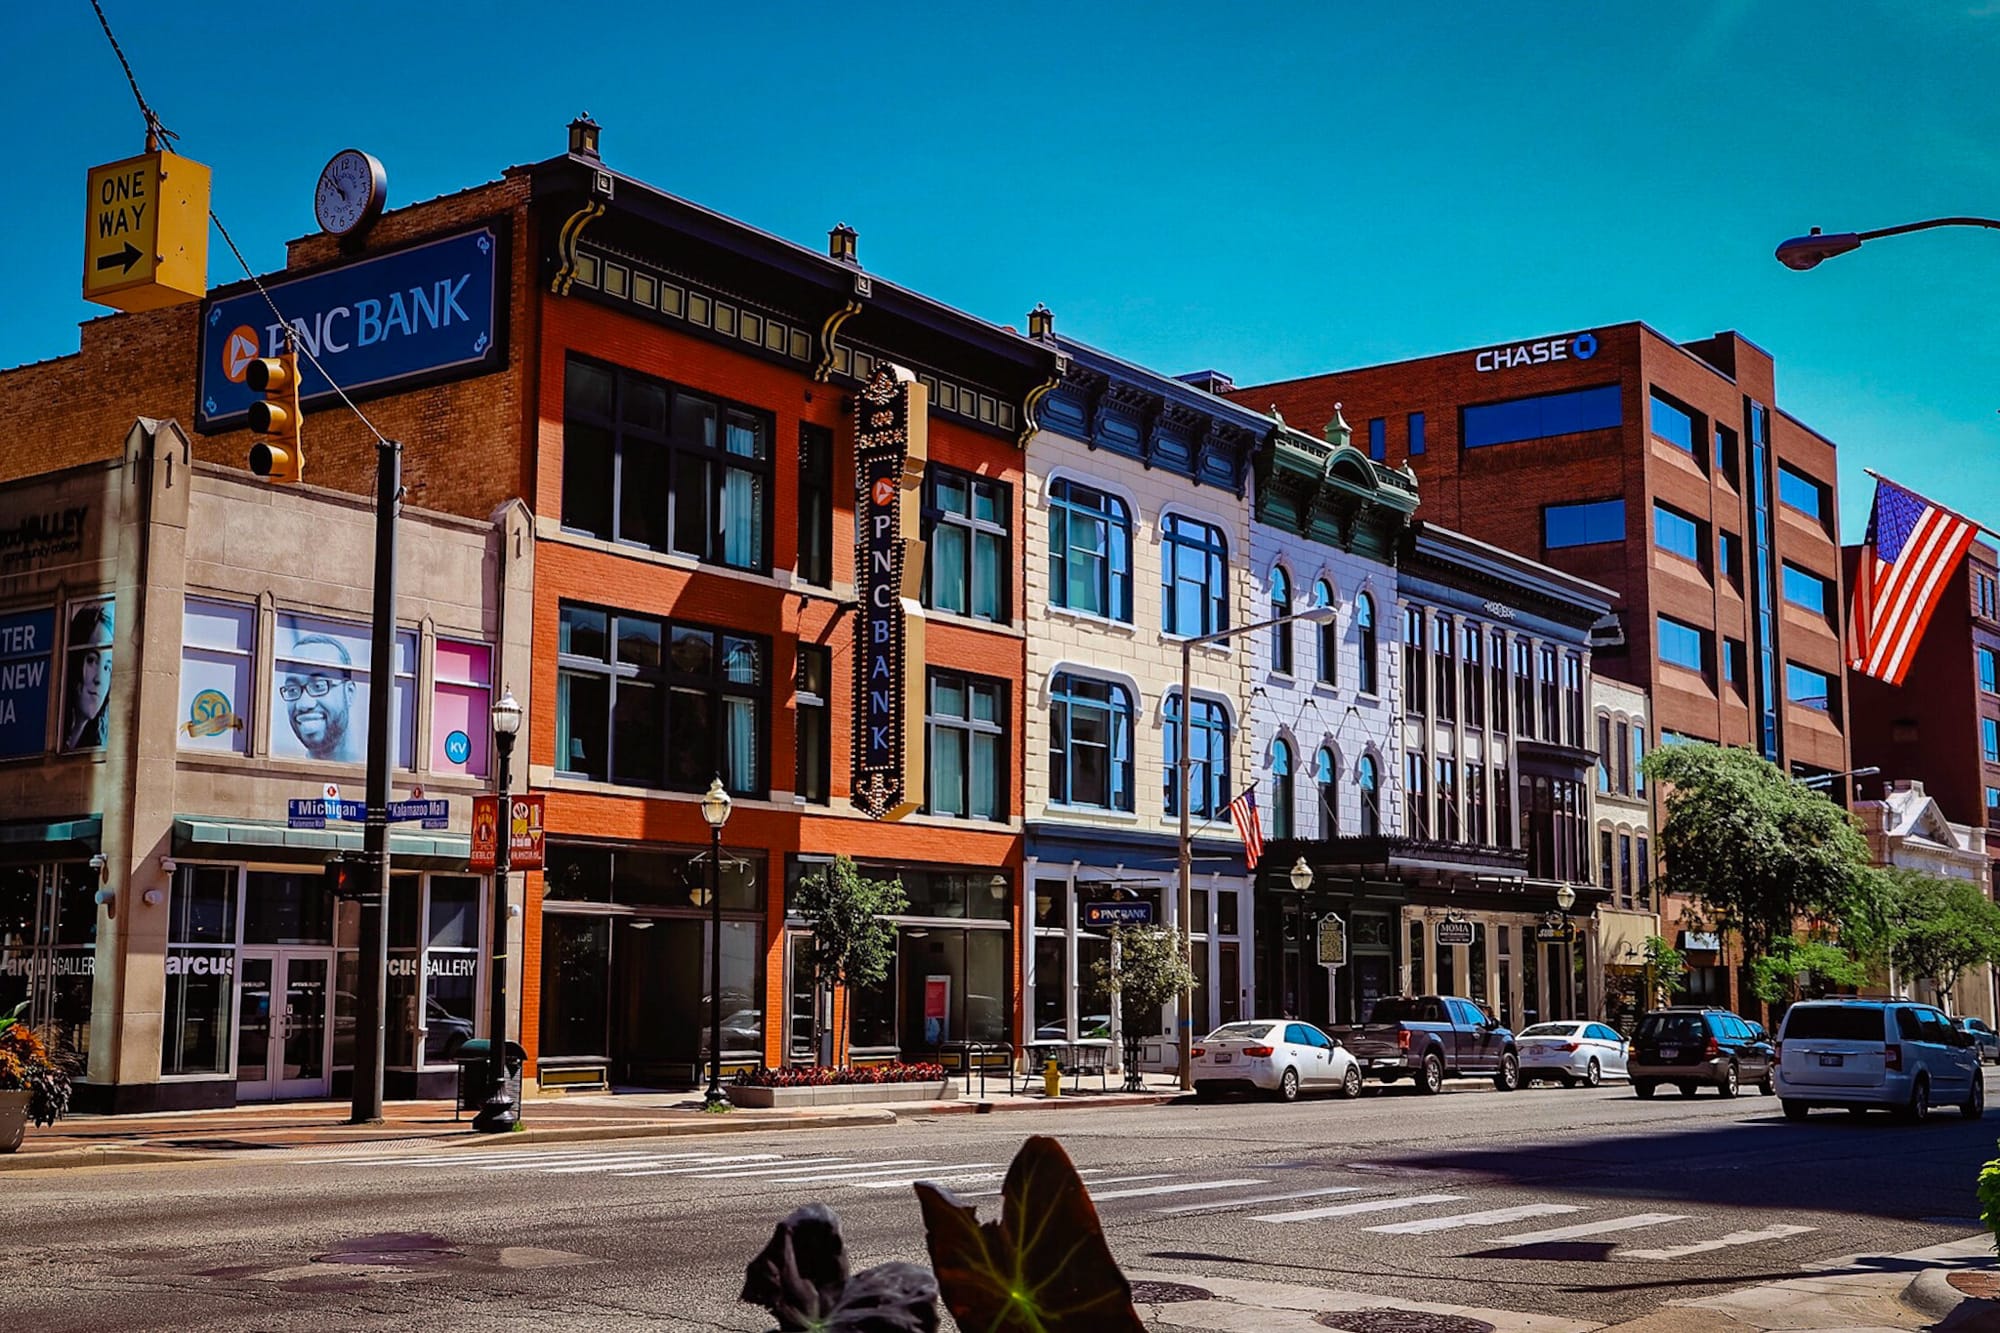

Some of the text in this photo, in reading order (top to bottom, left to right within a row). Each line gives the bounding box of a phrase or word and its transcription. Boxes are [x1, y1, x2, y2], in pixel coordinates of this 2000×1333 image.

[101, 171, 145, 205] ONE
[99, 202, 146, 239] WAY
[265, 273, 471, 359] PNC BANK
[1475, 339, 1568, 372] CHASE
[871, 515, 892, 750] PNC BANK
[2, 661, 45, 691] NEW
[450, 741, 467, 755] KV
[298, 801, 357, 819] Michigan
[393, 802, 428, 817] Kalamazoo
[429, 801, 446, 816] Mall
[1101, 909, 1146, 920] PNC BANK
